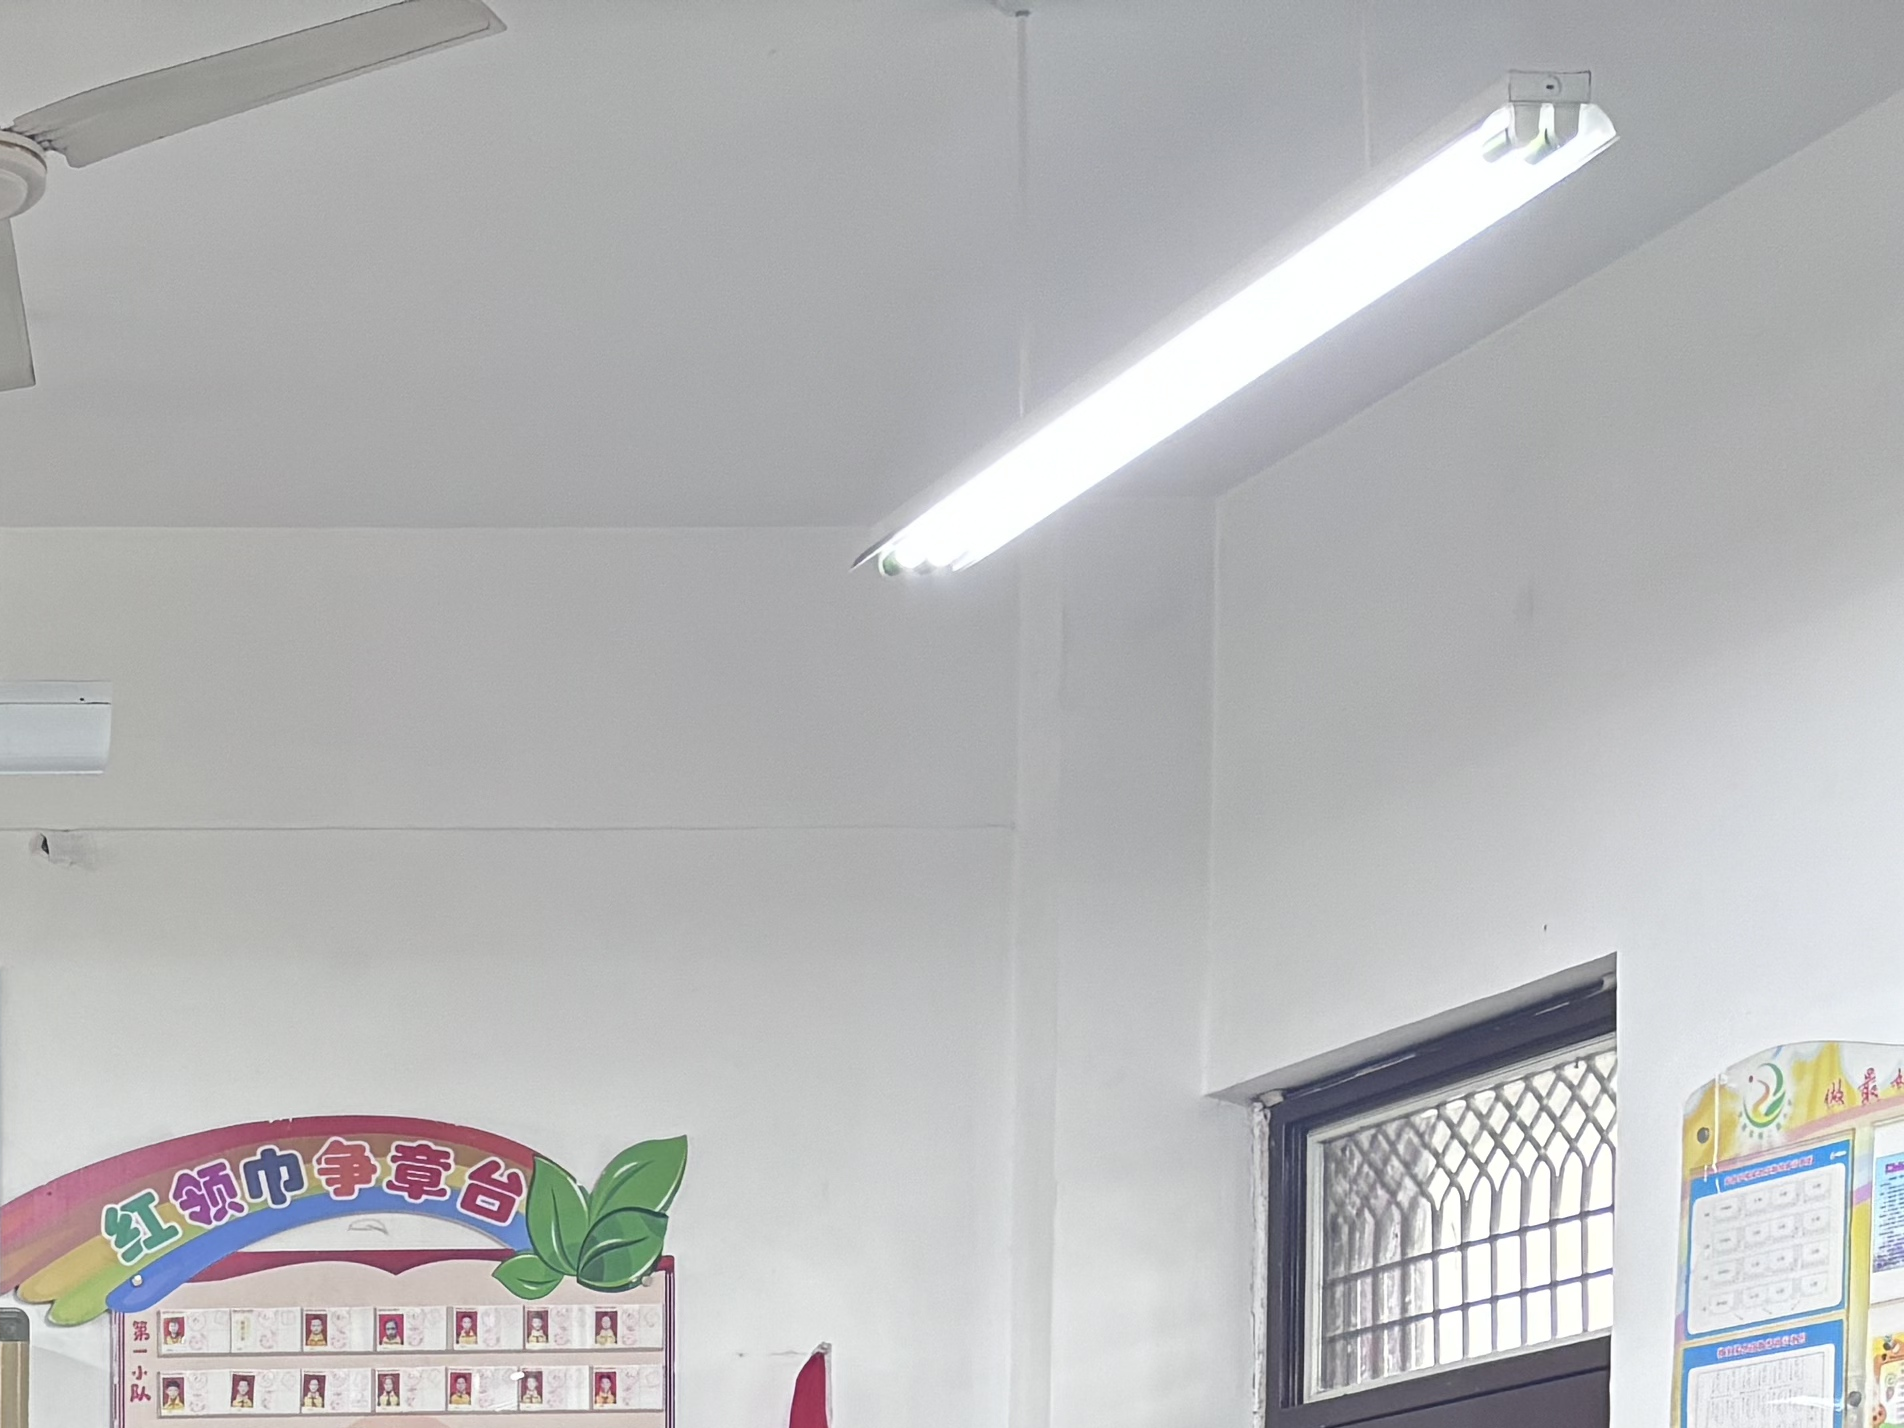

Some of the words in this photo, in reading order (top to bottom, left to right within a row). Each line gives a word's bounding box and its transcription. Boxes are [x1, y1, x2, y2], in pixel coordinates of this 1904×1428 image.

[101, 1136, 527, 1264] 红领巾争章台
[129, 1320, 152, 1403] 第一小队
